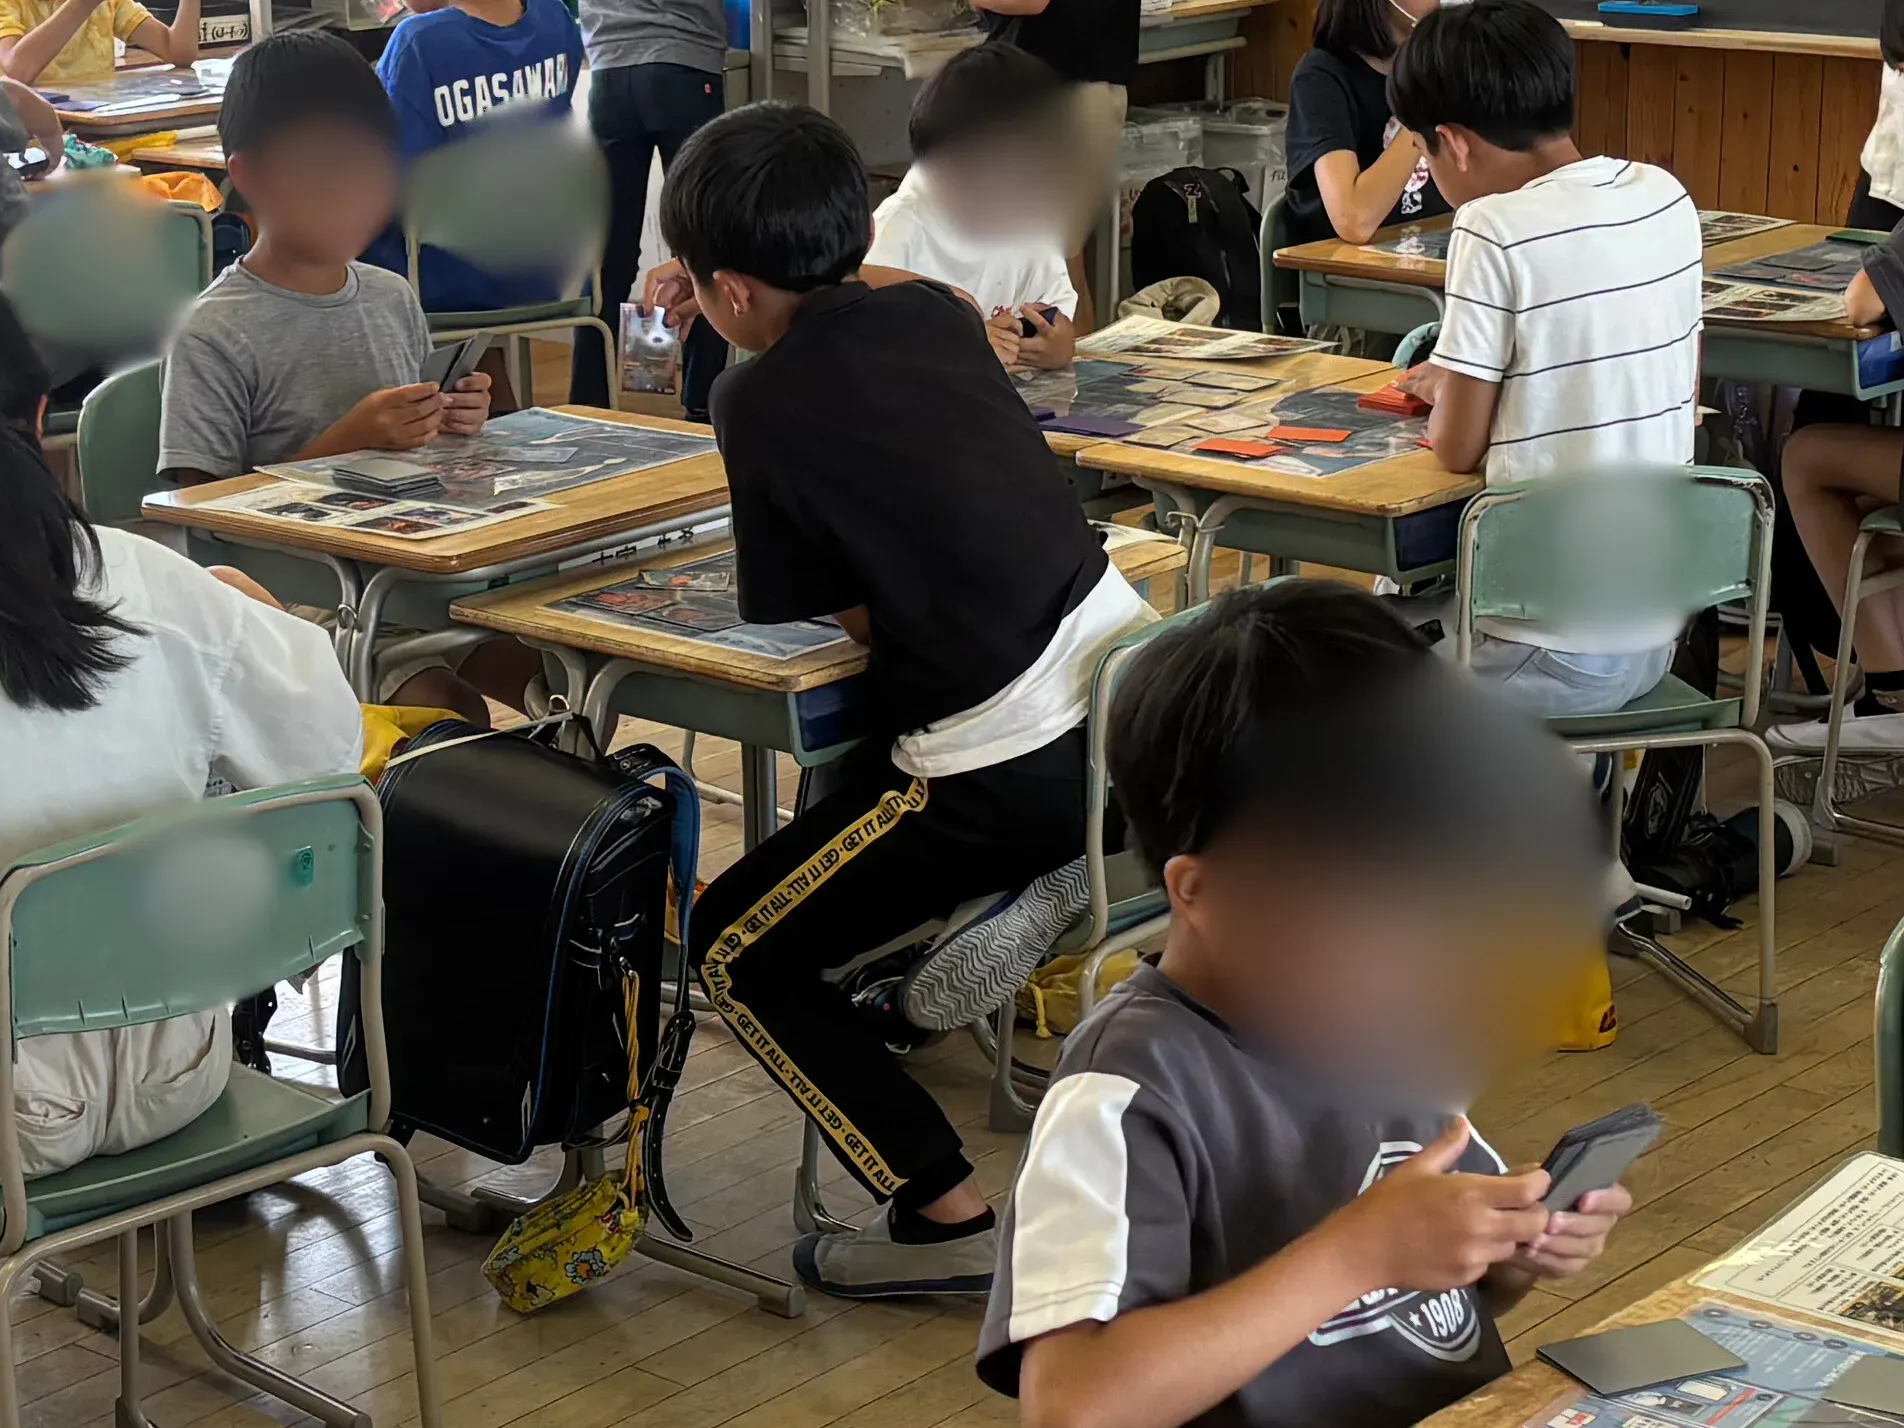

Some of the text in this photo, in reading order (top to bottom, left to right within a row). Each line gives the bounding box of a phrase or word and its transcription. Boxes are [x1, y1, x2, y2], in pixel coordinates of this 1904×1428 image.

[842, 828, 865, 852] GET
[737, 1013, 760, 1040] GET
[765, 1045, 787, 1073] ALL
[844, 1132, 870, 1160] GET
[874, 1167, 897, 1190] ALL
[1420, 1288, 1465, 1338] 1908
